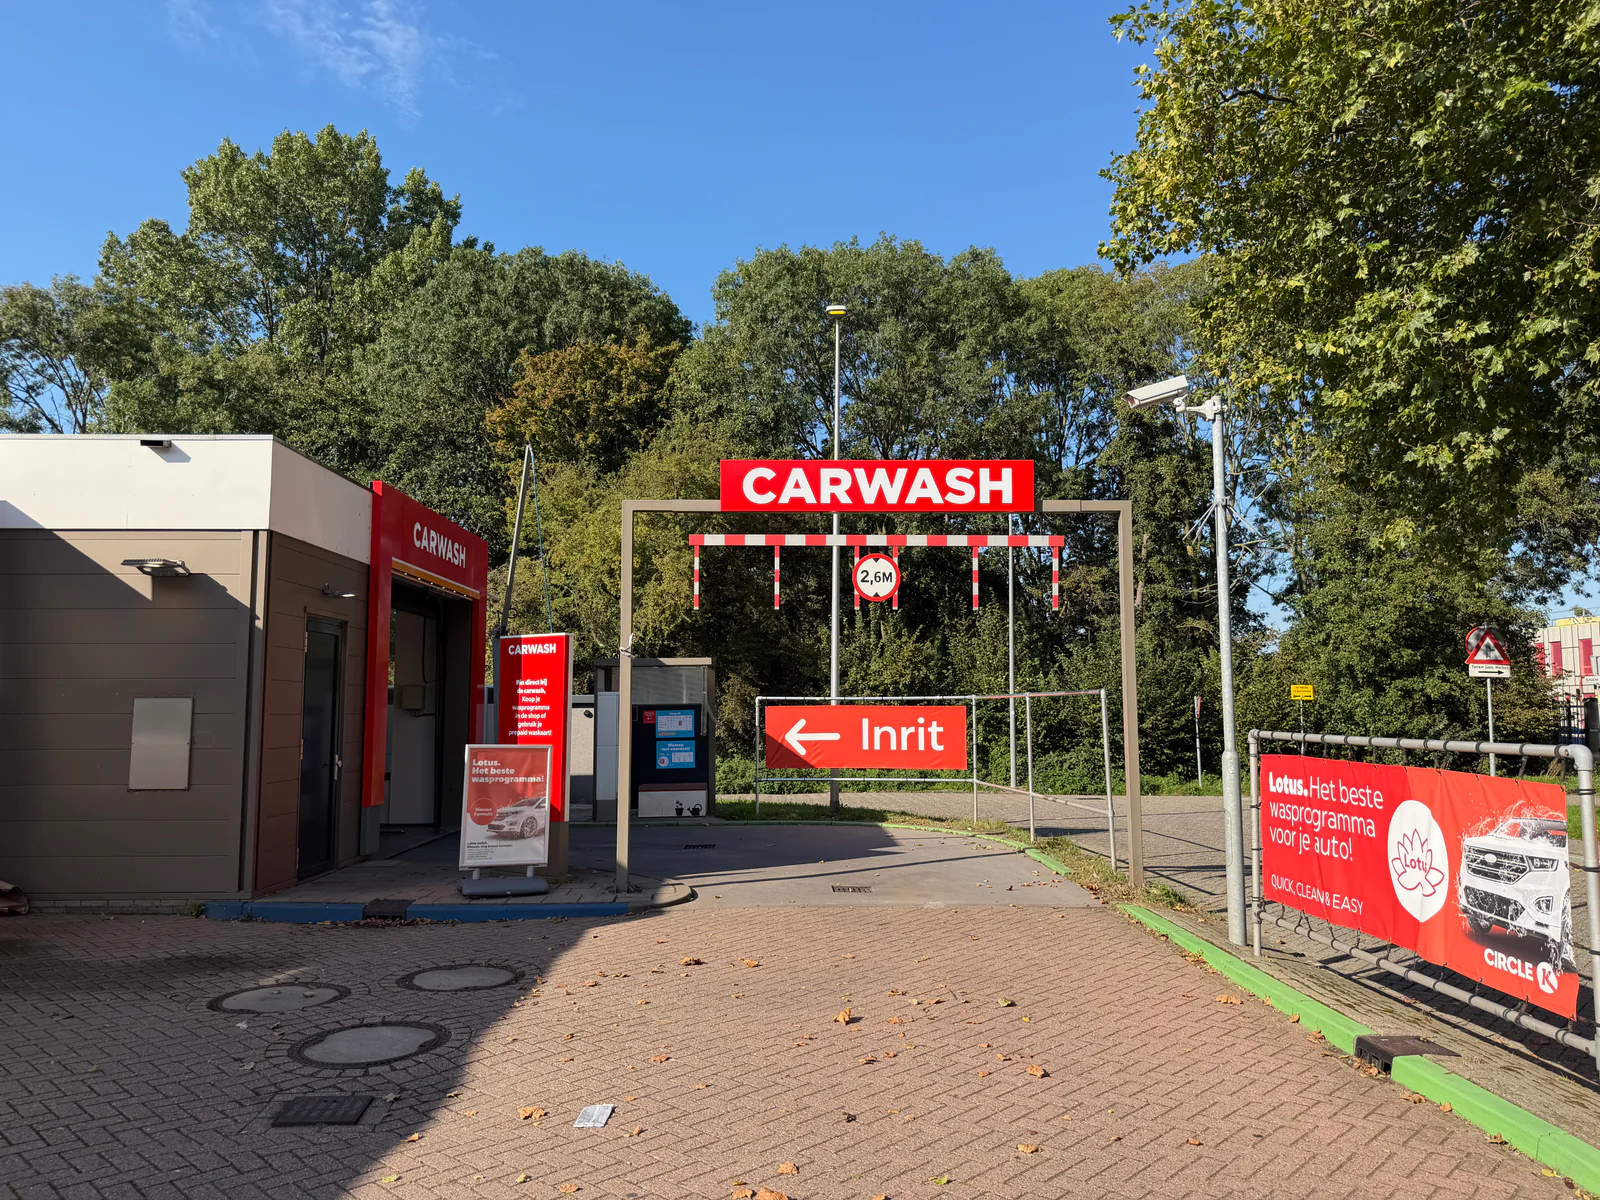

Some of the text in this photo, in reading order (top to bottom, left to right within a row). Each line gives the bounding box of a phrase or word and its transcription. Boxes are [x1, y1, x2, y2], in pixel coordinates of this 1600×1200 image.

[742, 467, 1013, 504] CARWASH
[413, 521, 467, 569] CARWASH
[860, 569, 893, 586] 2,6M
[508, 643, 556, 655] CARWASH
[540, 679, 548, 687] bij
[862, 717, 944, 751] Inrit
[471, 767, 515, 775] Het beste
[471, 776, 544, 784] wasprogramma!
[472, 759, 501, 767] Lotus.
[1268, 771, 1384, 810] Lotus. Het beste
[1269, 801, 1376, 838] wasprogramma
[1269, 826, 1353, 862] voor je auto!
[1271, 873, 1296, 896] QUICK,
[1296, 882, 1325, 904] CLEAN
[1332, 893, 1364, 916] EASY
[1484, 947, 1534, 982] CIRCLE
